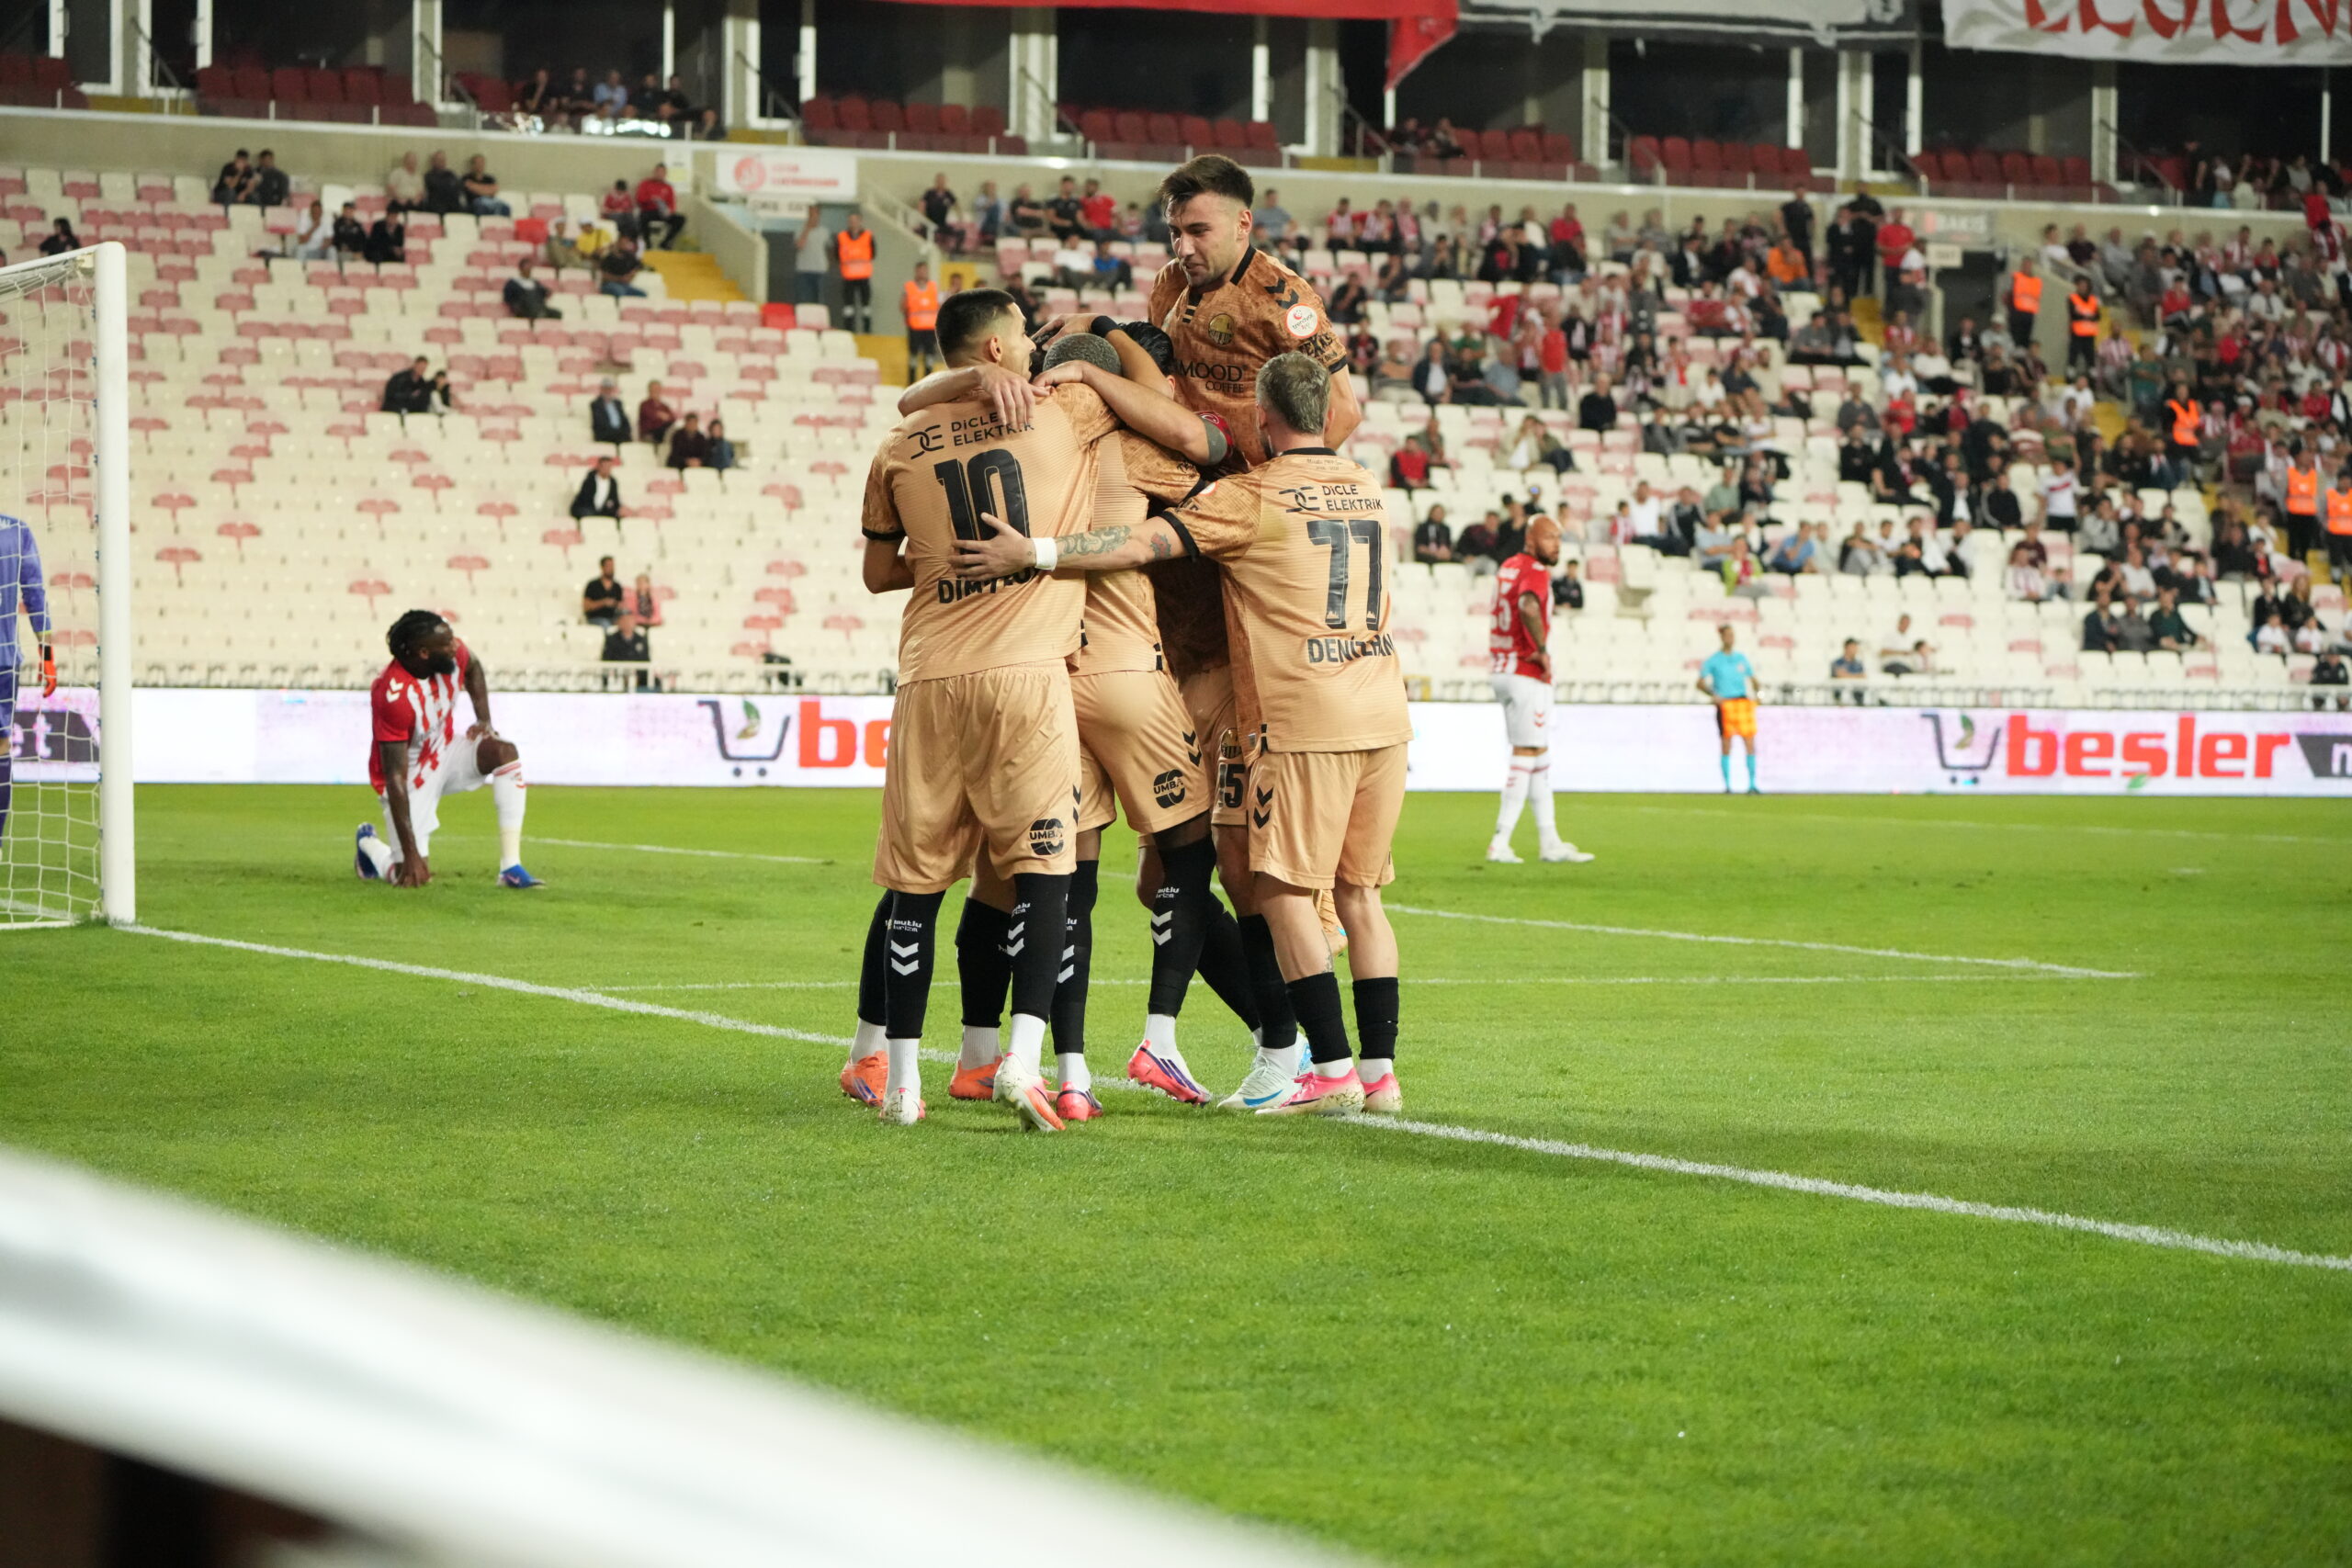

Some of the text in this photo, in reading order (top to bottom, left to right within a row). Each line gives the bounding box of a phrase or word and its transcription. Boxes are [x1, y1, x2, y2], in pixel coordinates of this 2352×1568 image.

[1180, 359, 1243, 382] MOOD
[1205, 380, 1244, 393] COFFEE
[933, 448, 1030, 556] 10
[1306, 519, 1383, 631] 77
[2007, 712, 2291, 779] besler
[893, 919, 922, 929] mutlu
